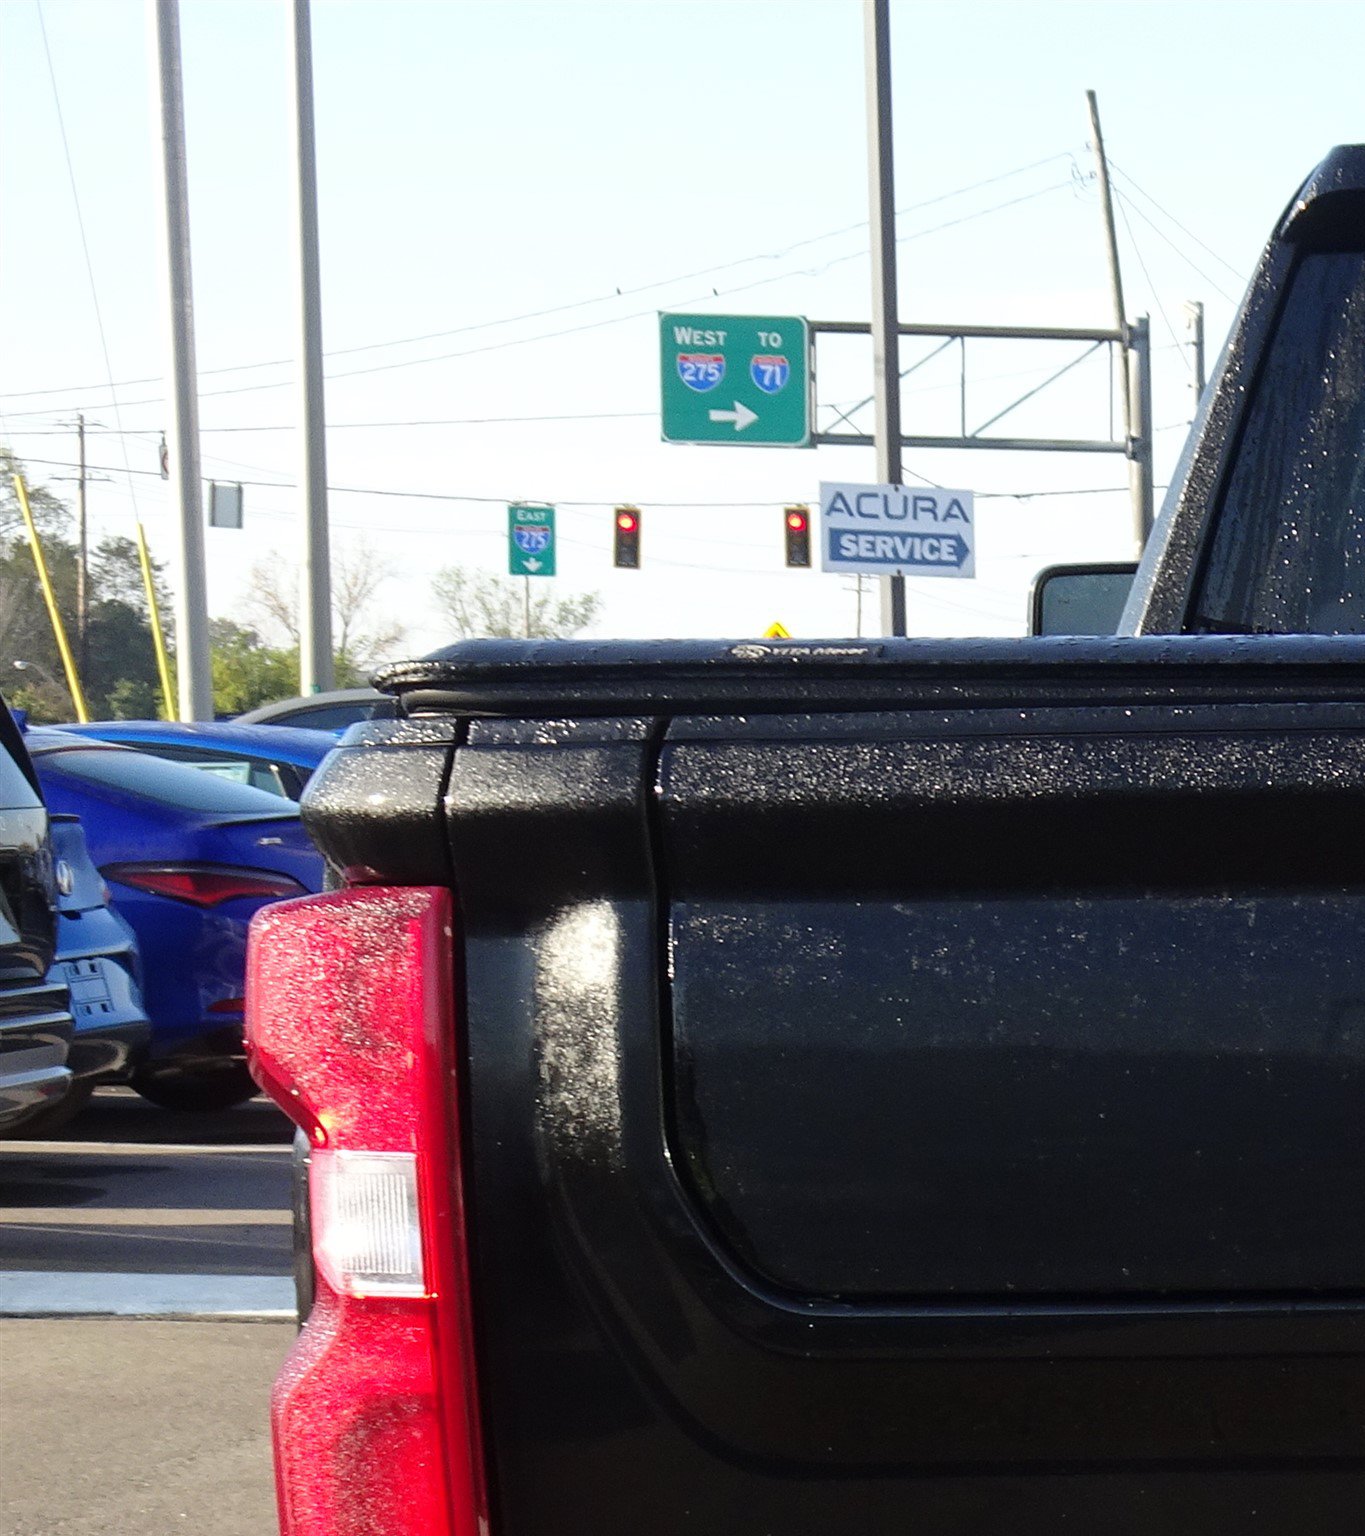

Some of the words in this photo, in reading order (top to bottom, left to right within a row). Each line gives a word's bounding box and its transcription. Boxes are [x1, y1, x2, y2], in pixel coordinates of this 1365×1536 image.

[673, 326, 727, 346] WEST
[757, 331, 783, 348] TO
[683, 363, 720, 381] 275
[759, 365, 782, 386] 71
[517, 509, 545, 521] EAST
[825, 491, 971, 523] ACURA
[522, 531, 546, 548] 275
[839, 534, 958, 561] SERVICE
